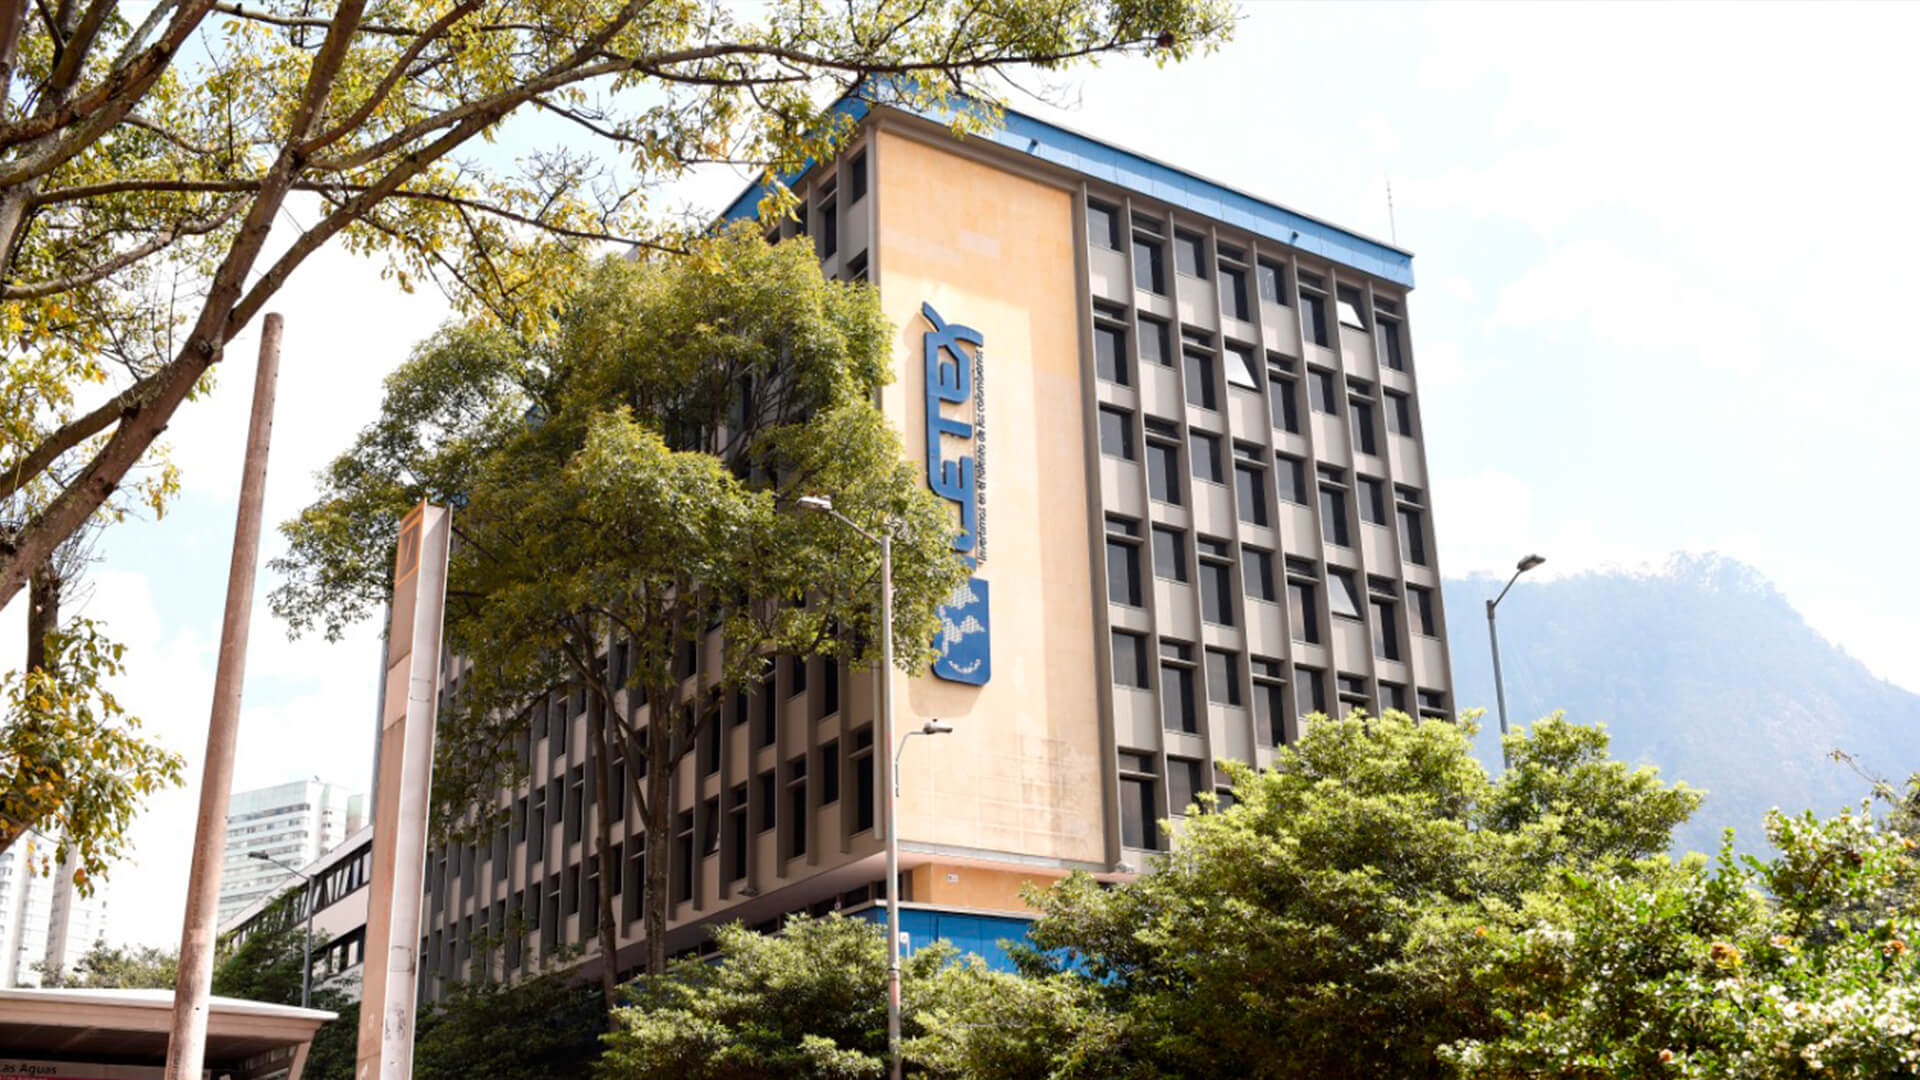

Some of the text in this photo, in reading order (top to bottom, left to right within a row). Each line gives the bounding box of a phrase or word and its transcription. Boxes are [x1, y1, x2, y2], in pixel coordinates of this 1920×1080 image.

[976, 429, 985, 443] de
[977, 494, 986, 506] en
[19, 1063, 57, 1076] Aguas
